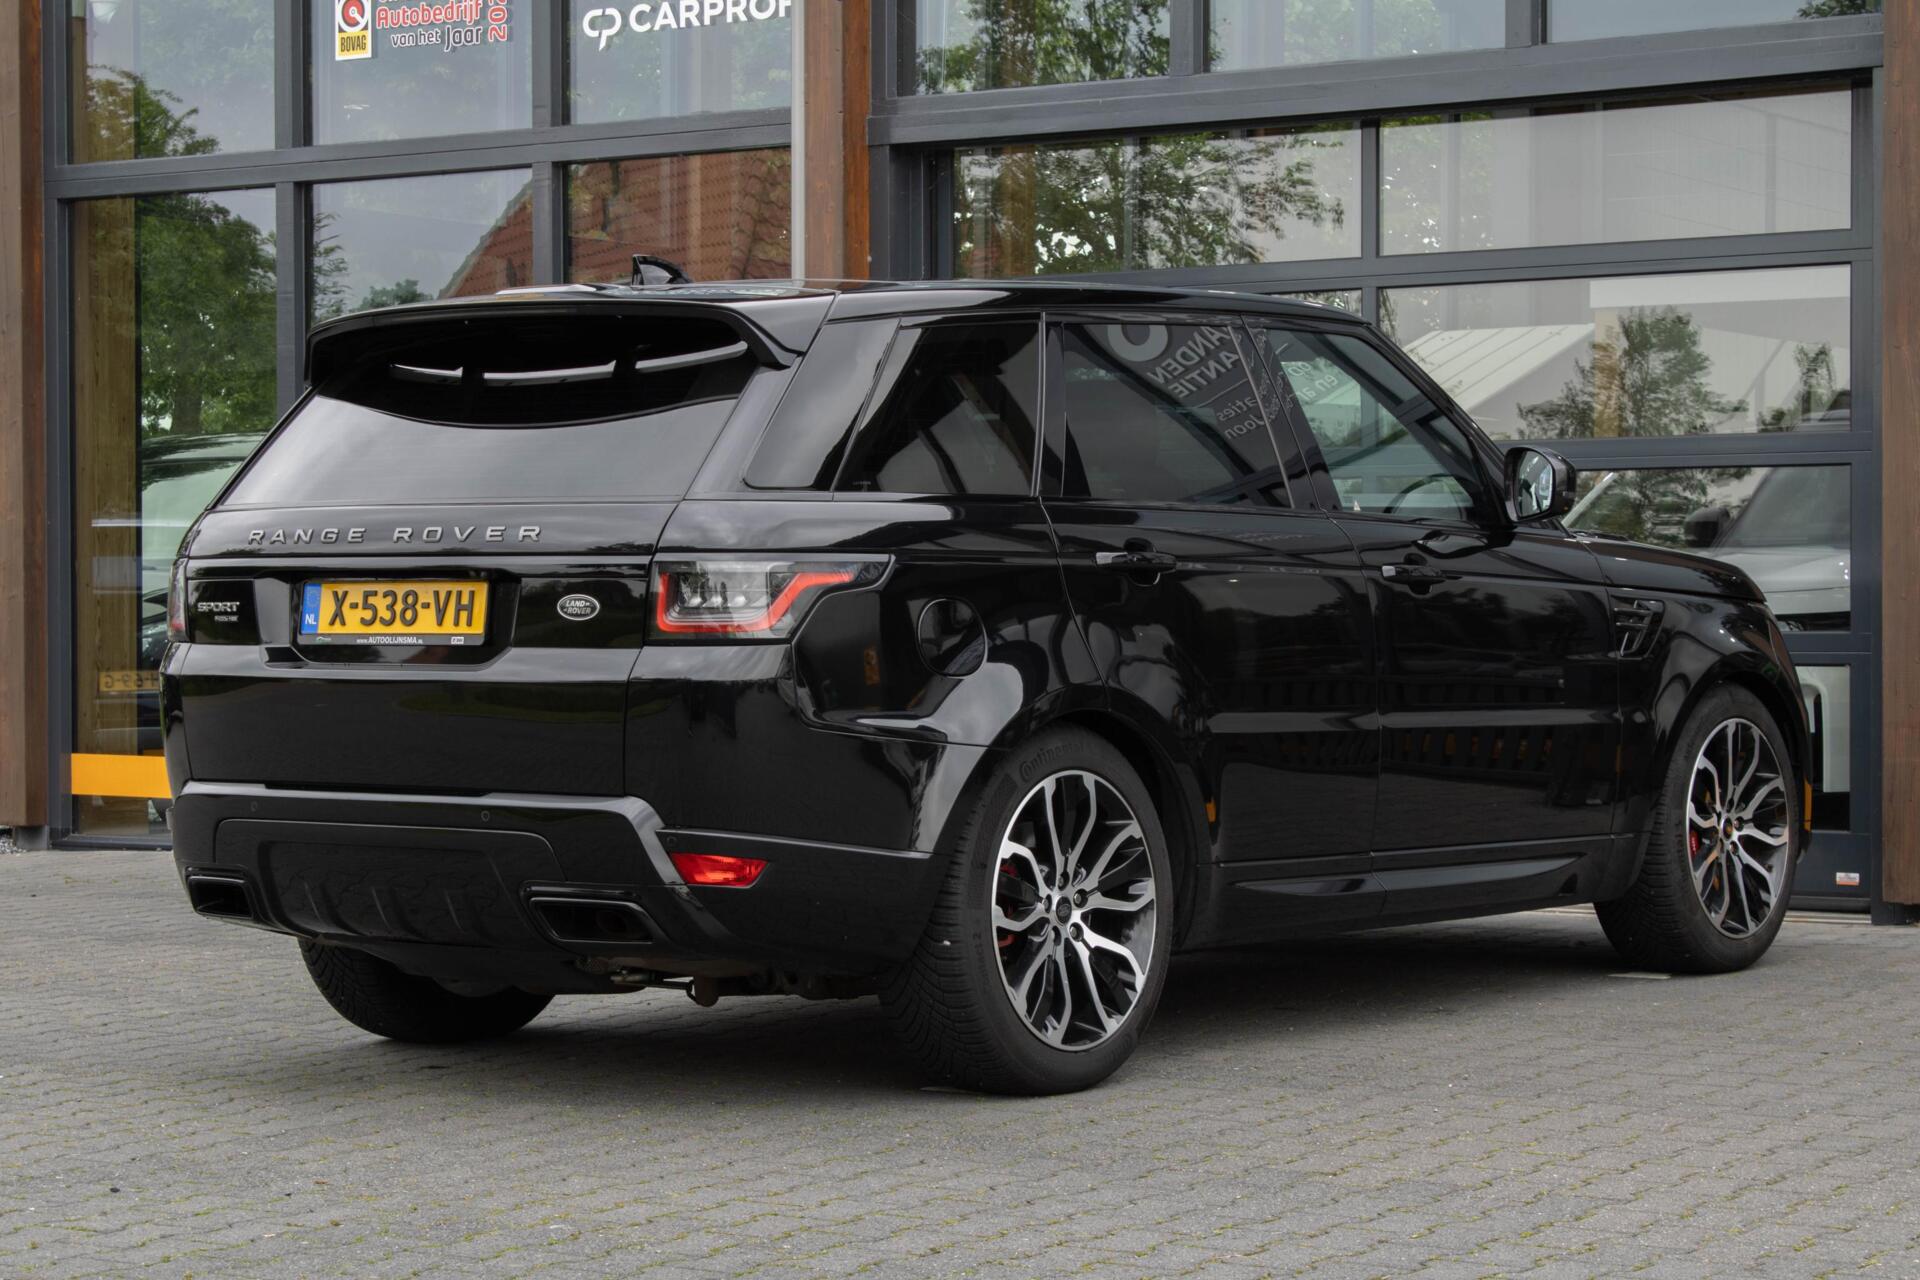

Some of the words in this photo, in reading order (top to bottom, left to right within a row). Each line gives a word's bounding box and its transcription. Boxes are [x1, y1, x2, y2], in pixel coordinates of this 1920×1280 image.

[376, 0, 483, 29] Autobedrijf
[340, 34, 367, 53] BOVAG
[391, 32, 416, 47] van
[418, 29, 441, 46] het
[247, 527, 367, 545] RANGE
[392, 525, 543, 544] ROVER
[197, 601, 240, 612] SPORT
[328, 589, 476, 627] X-538-VH
[566, 600, 586, 608] LAND
[567, 607, 592, 615] ROVER
[304, 613, 317, 625] NL
